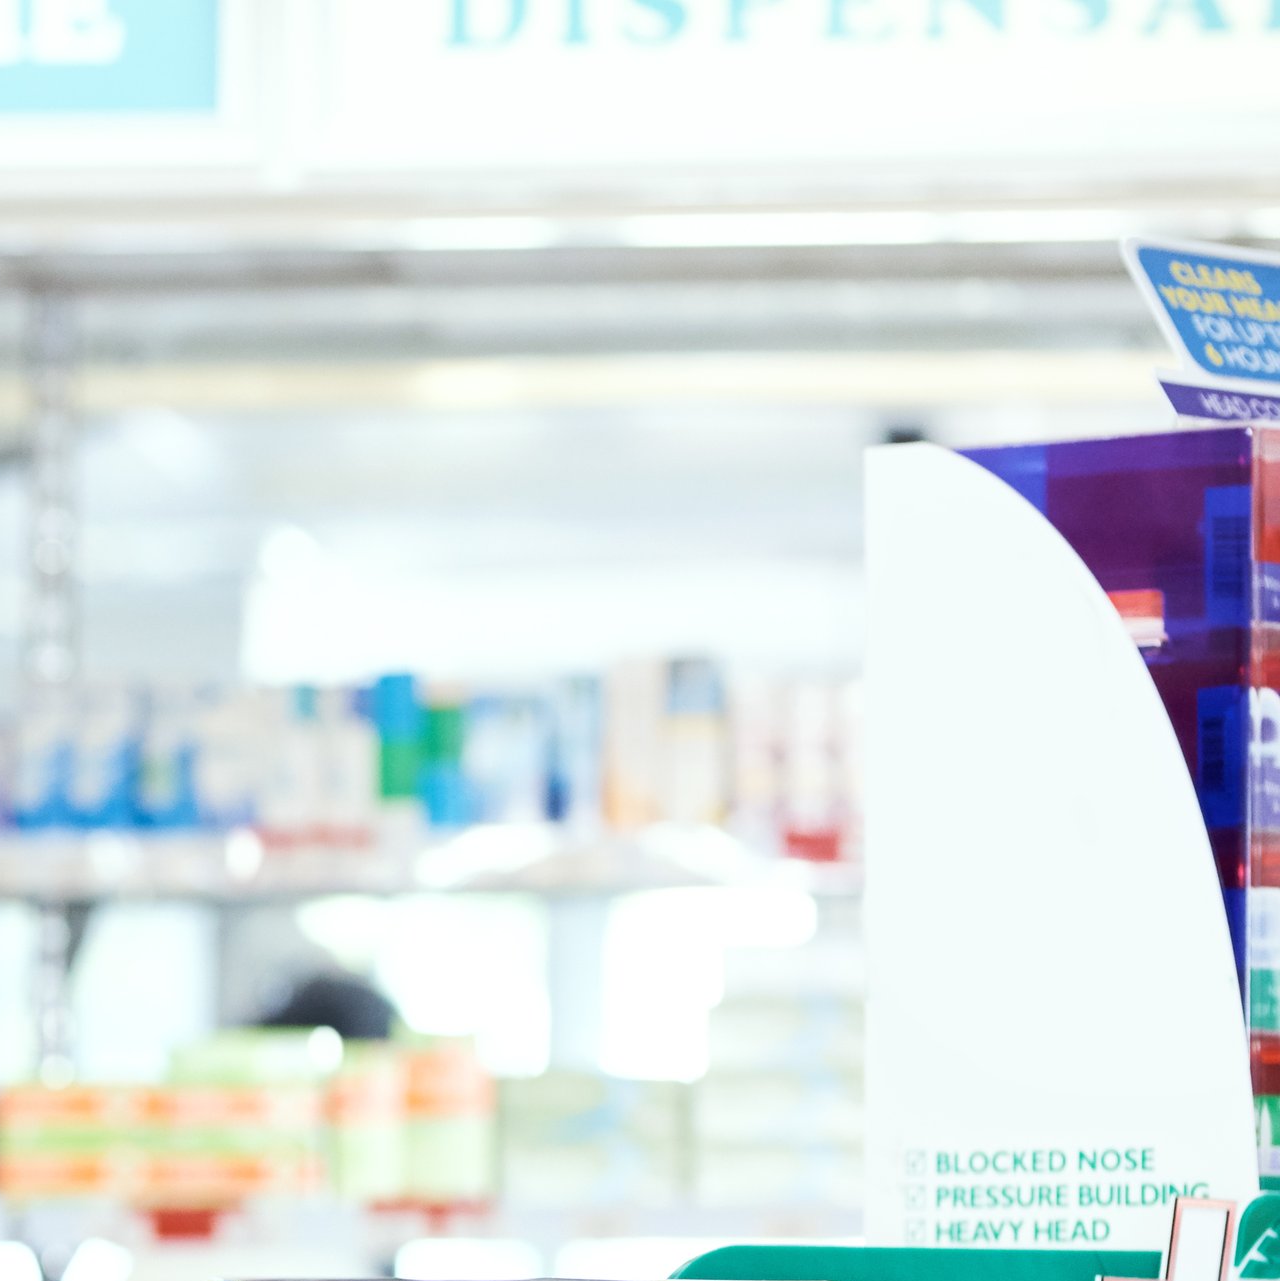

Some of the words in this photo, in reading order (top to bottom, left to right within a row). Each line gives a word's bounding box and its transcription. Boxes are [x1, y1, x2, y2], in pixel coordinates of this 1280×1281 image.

[444, 0, 1280, 49] DISPENSA
[1169, 261, 1262, 296] CLEARS
[1159, 284, 1232, 316] YOUR
[1191, 314, 1239, 342] FOR
[1200, 392, 1251, 418] HEAD
[936, 1150, 1067, 1174] BLOCKED
[1078, 1148, 1155, 1171] NOSE
[936, 1184, 1068, 1208] PRESSURE
[936, 1220, 1023, 1243] HEAVY
[1034, 1219, 1111, 1242] HEAD
